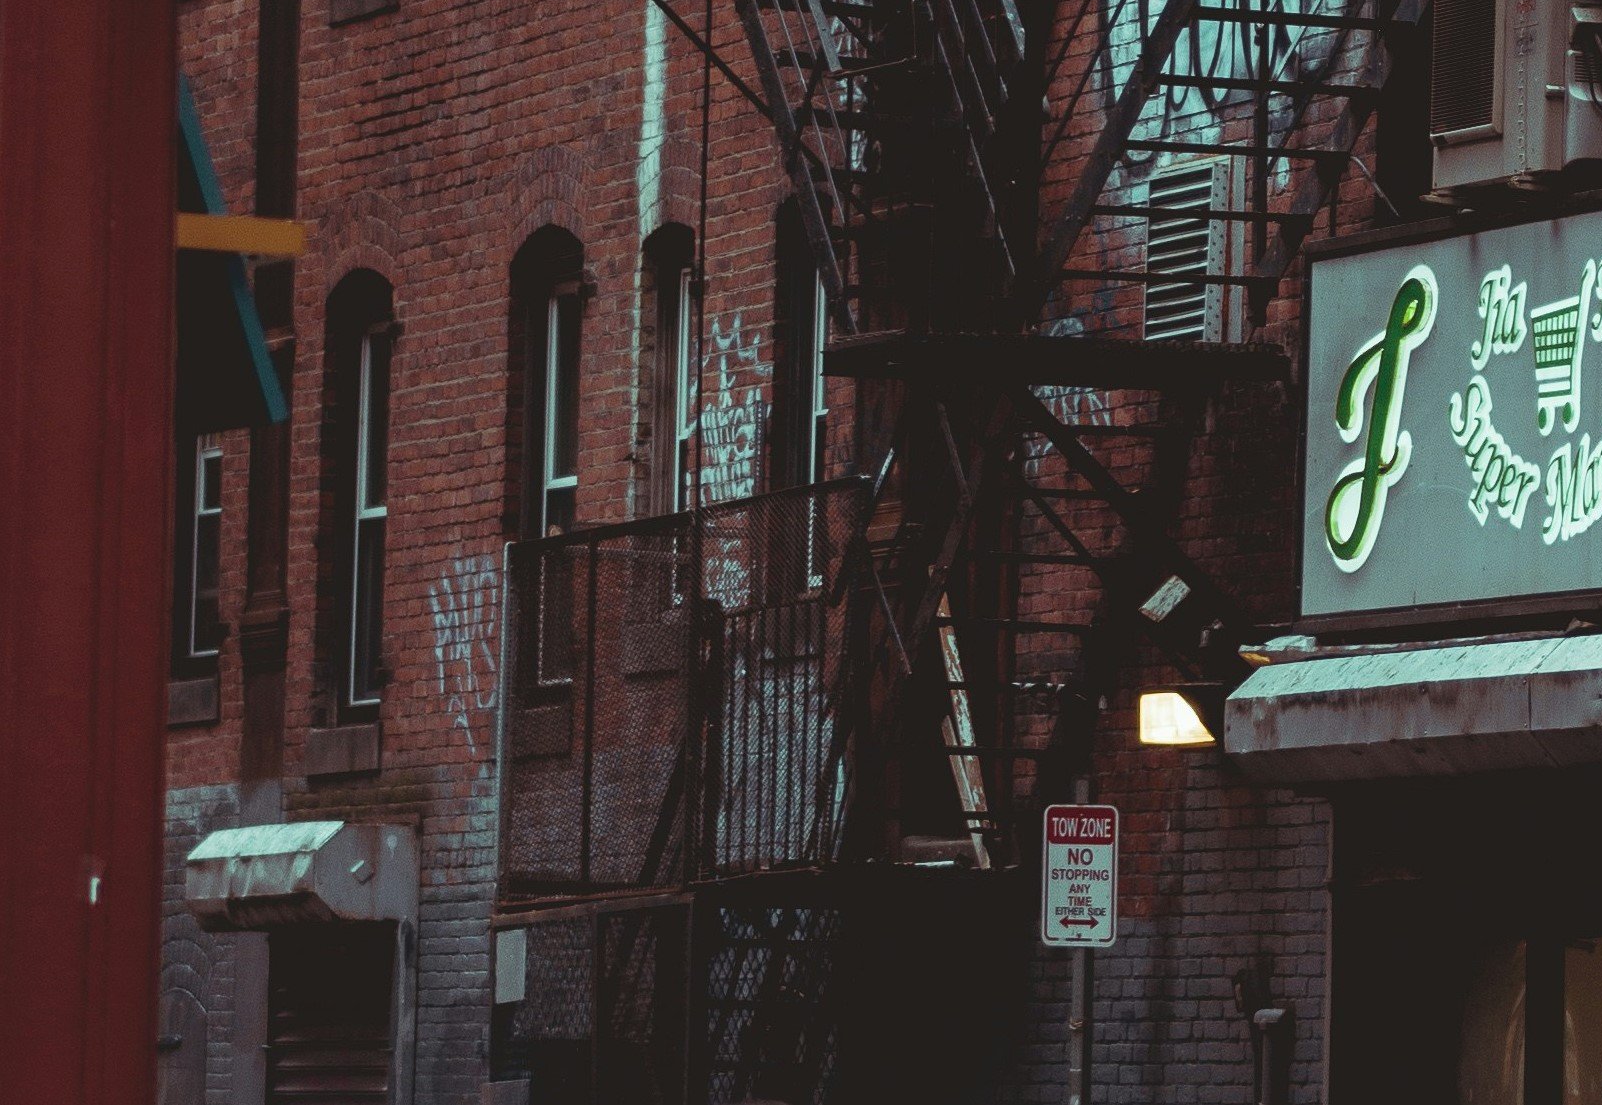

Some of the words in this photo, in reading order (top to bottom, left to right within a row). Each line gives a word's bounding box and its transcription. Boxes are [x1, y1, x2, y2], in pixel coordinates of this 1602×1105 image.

[1472, 264, 1527, 371] Jia
[1450, 375, 1541, 528] Super
[1052, 817, 1079, 837] TOW
[1080, 818, 1111, 838] ZONE
[1067, 848, 1093, 866] NO
[1051, 868, 1110, 881] STOPPING
[1068, 883, 1091, 894] ANY
[1067, 895, 1092, 907] TIME
[1055, 906, 1085, 916] EITHER
[1087, 906, 1107, 916] SIDE
